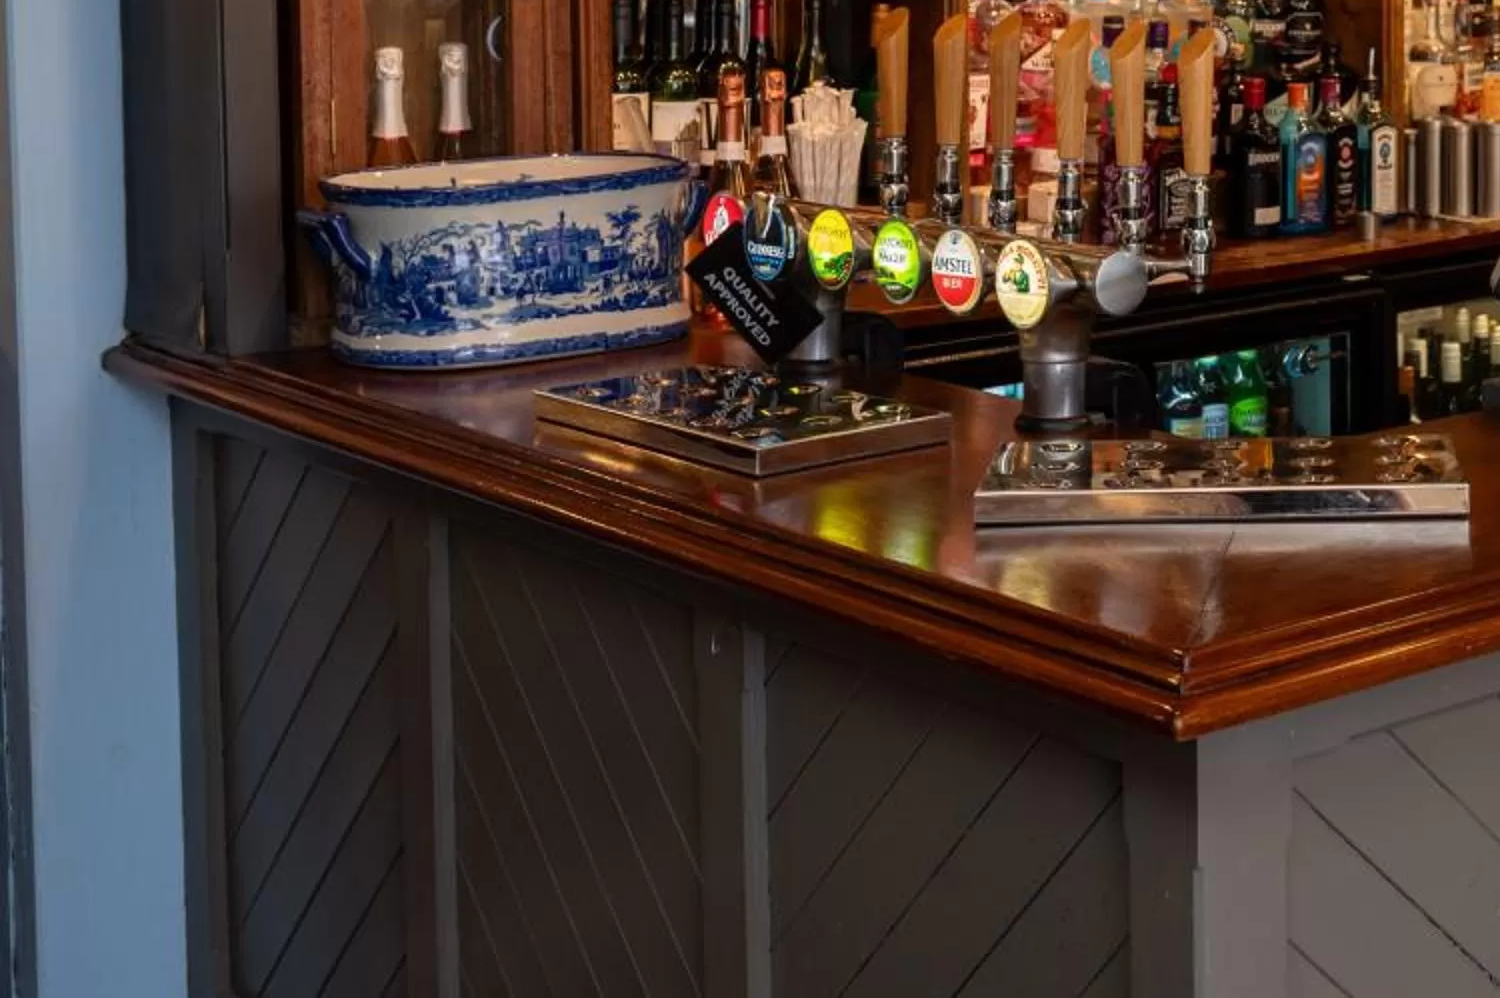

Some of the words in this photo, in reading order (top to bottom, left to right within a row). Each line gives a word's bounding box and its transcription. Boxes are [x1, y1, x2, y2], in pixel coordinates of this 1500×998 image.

[934, 255, 973, 276] AMSTEL
[703, 273, 772, 347] APPROVED
[722, 266, 780, 328] QUALITY
